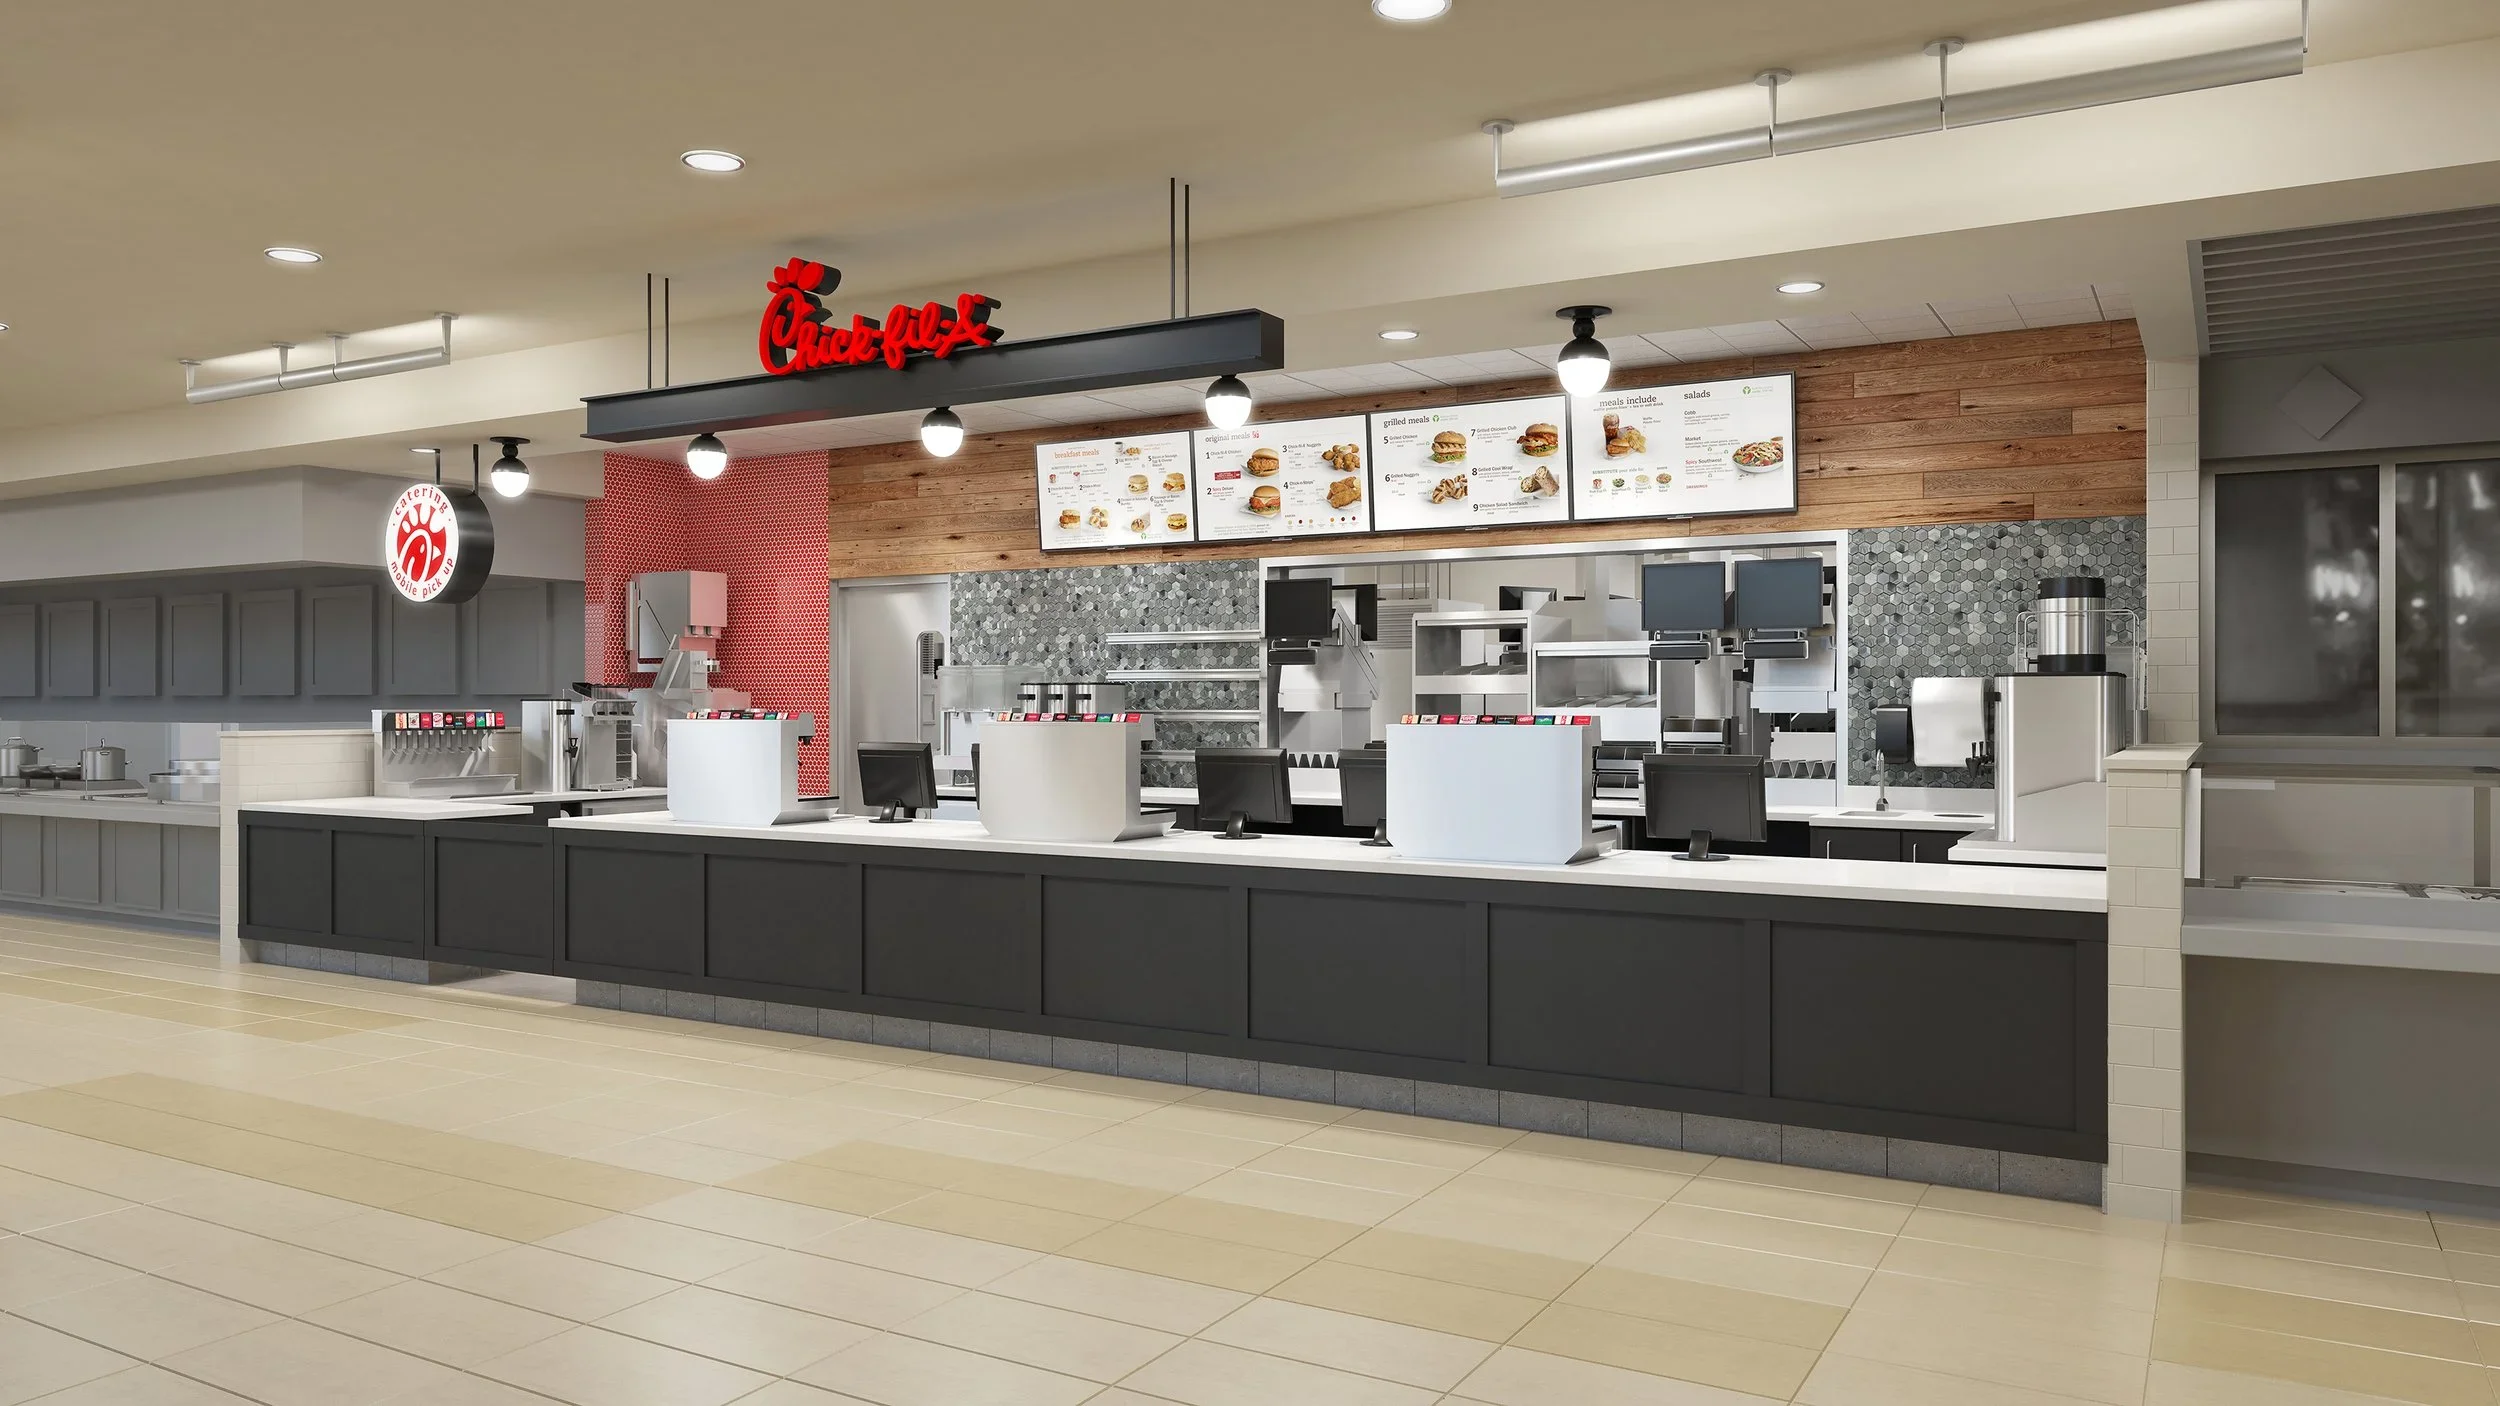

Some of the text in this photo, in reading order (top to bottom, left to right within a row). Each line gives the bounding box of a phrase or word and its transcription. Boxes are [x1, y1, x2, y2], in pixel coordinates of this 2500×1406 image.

[758, 257, 993, 375] Chick-fil-A
[1684, 390, 1711, 400] salads
[1599, 395, 1657, 407] meals include
[1384, 417, 1406, 428] grilled
[1408, 416, 1430, 424] meals
[1471, 429, 1476, 437] 7
[1205, 432, 1250, 444] original meals
[1384, 436, 1388, 444] 5
[1054, 450, 1081, 459] breakfast
[1082, 448, 1100, 457] meals
[1282, 445, 1288, 453] 3
[1472, 467, 1477, 476] 8
[1385, 474, 1390, 482] 6
[1283, 481, 1288, 489] 4
[1206, 487, 1211, 495] 2
[395, 487, 448, 516] catering
[1473, 503, 1478, 512] 9
[391, 558, 454, 598] mobile pick up
